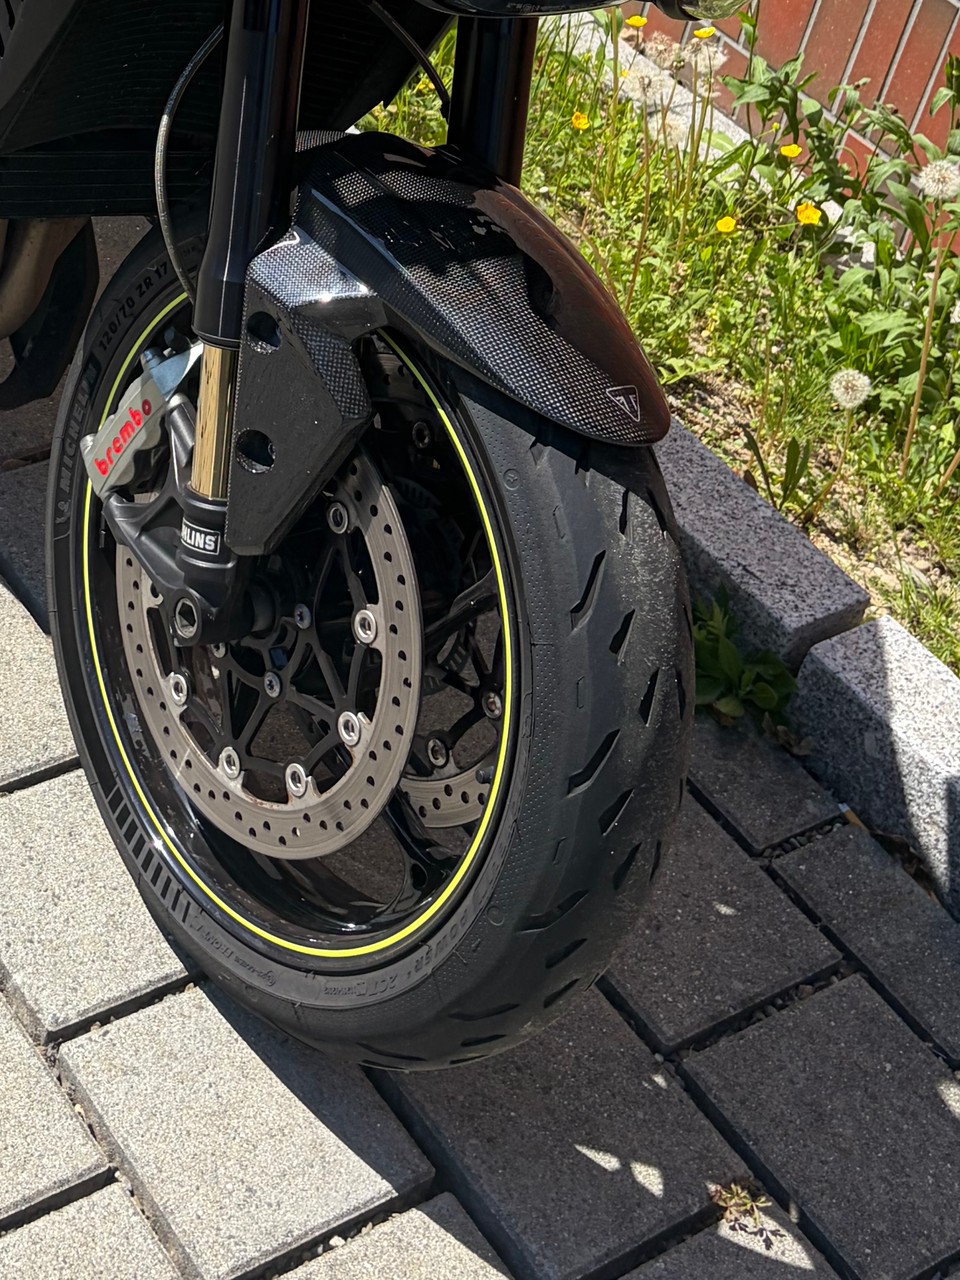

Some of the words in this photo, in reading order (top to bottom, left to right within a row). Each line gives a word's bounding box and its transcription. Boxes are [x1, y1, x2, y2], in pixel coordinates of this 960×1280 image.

[99, 295, 136, 352] 120/70
[136, 276, 155, 298] ZR
[154, 261, 169, 280] 17
[60, 363, 98, 494] MICHELIN
[94, 398, 152, 477] brembo
[181, 524, 216, 551] HLINS
